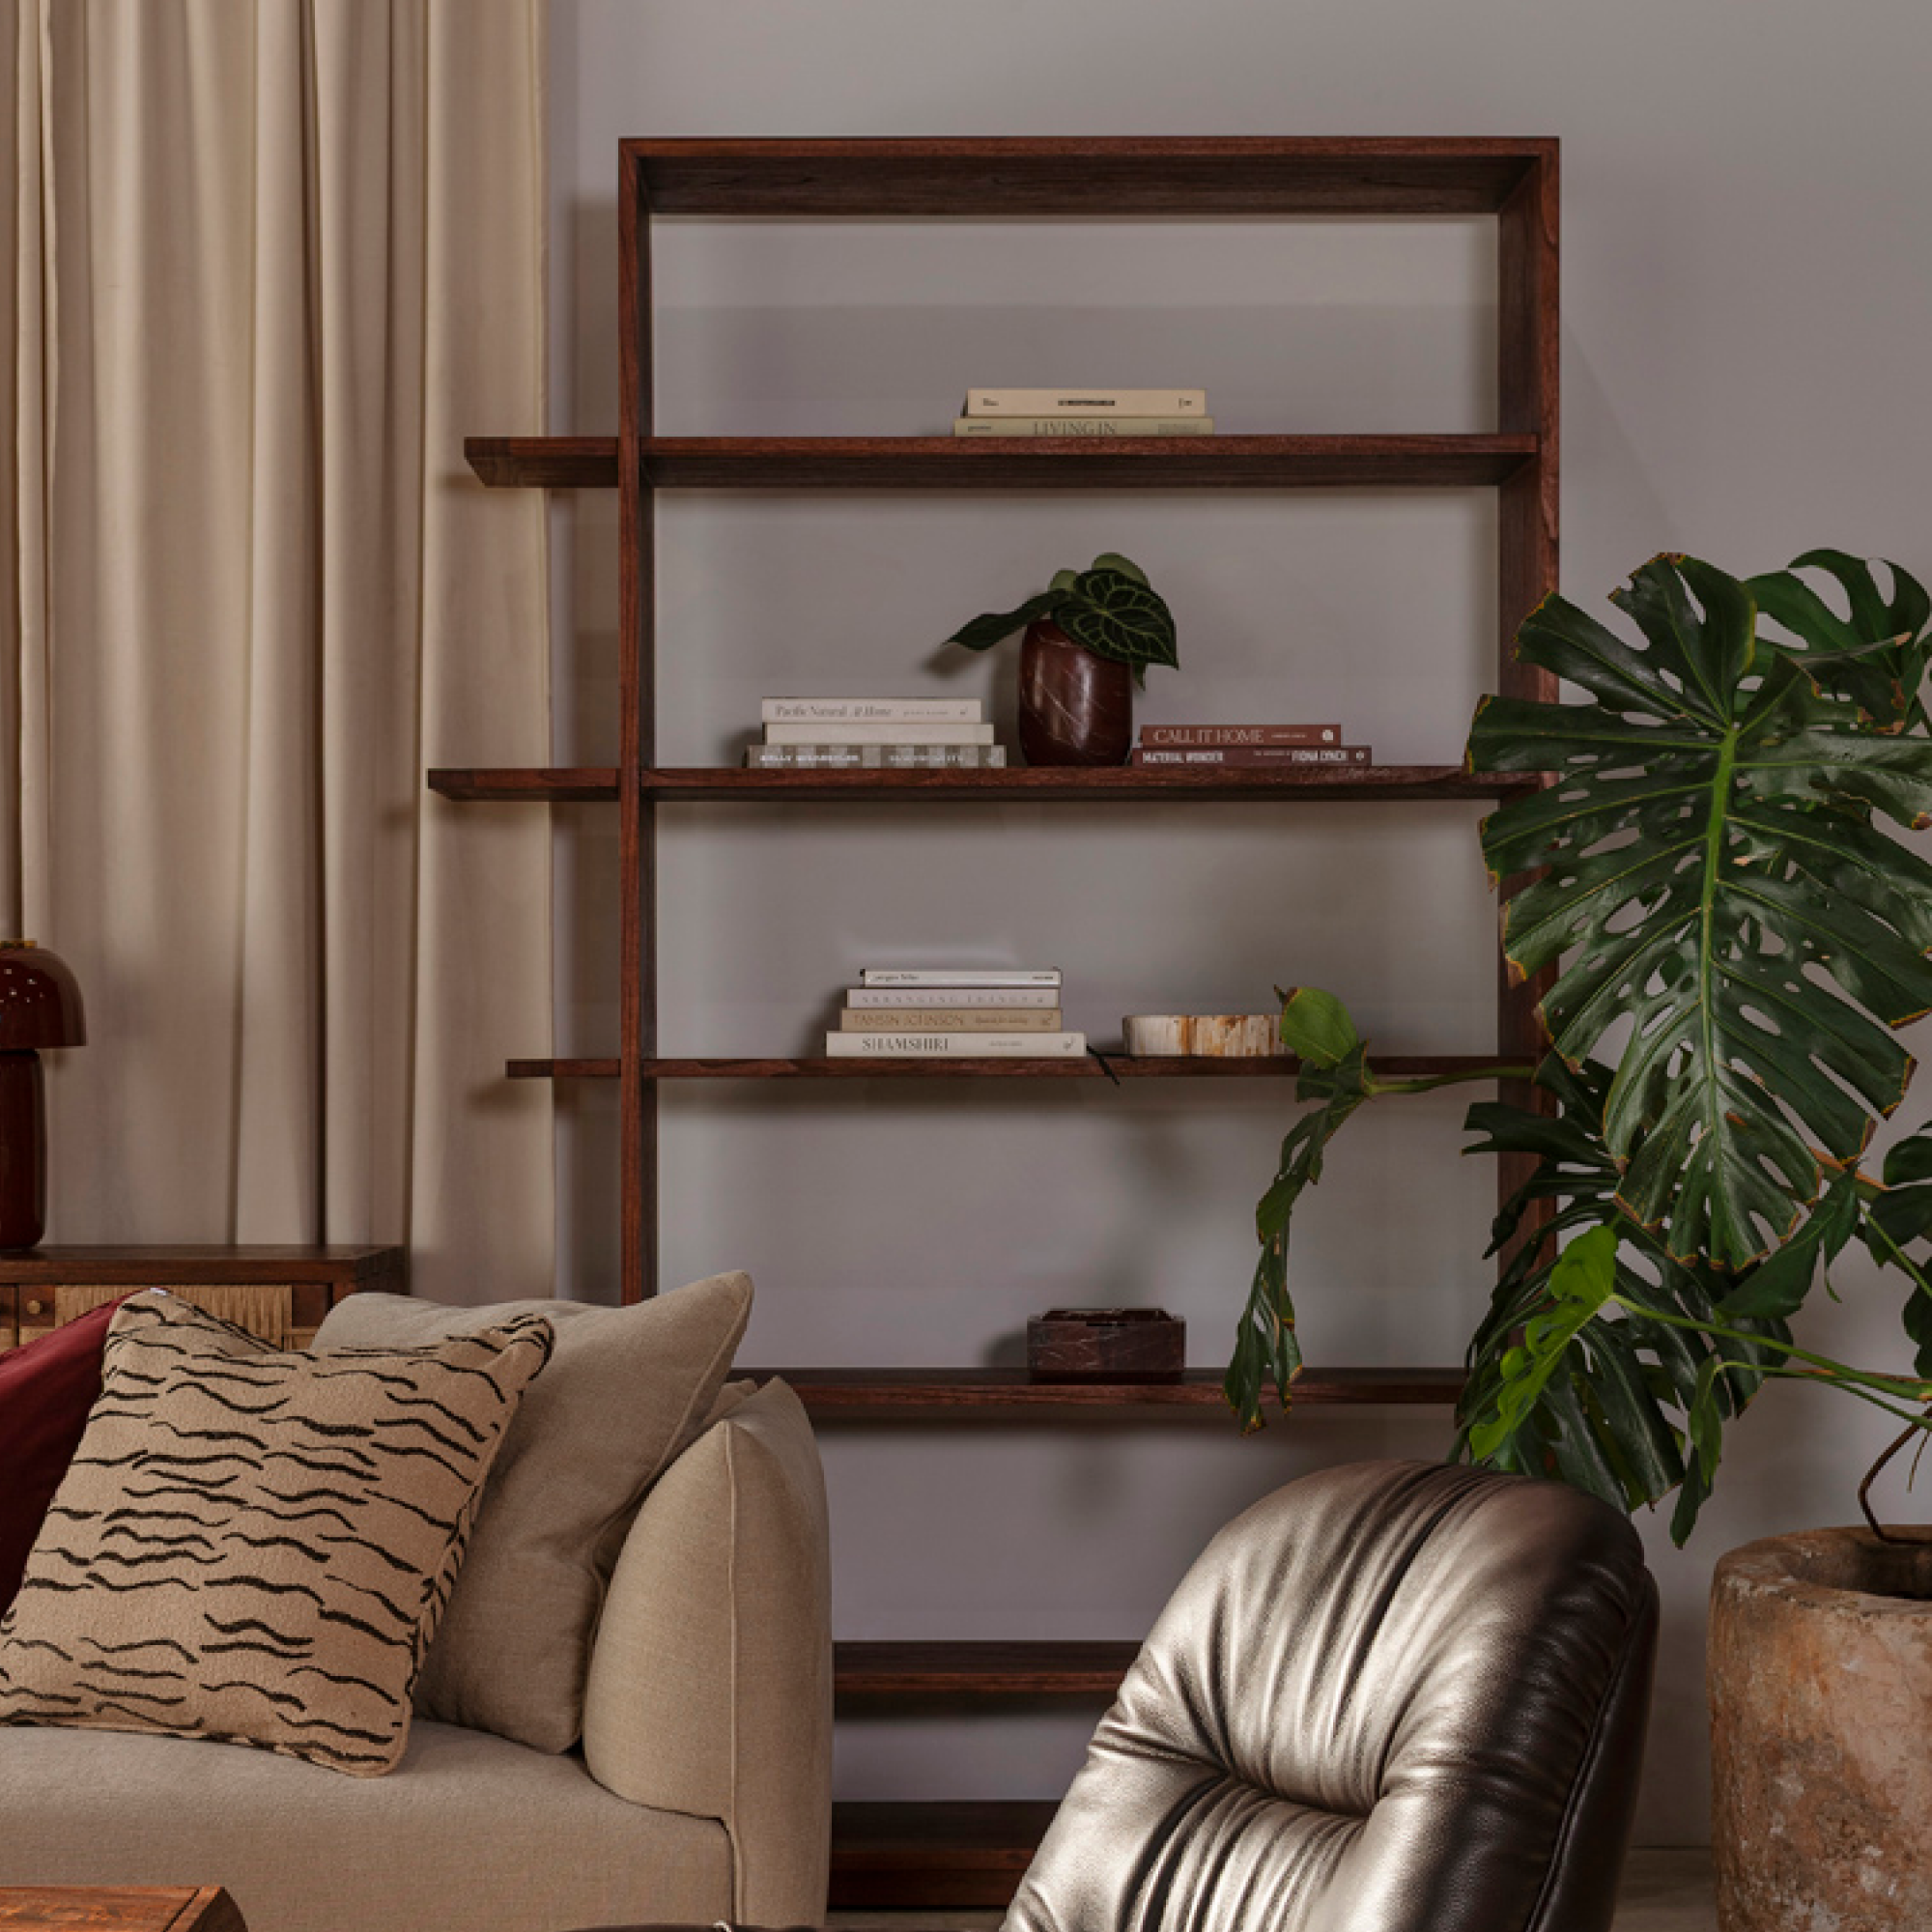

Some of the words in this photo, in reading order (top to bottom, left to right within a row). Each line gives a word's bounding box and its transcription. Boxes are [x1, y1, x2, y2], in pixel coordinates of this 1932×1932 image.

[1034, 420, 1094, 435] LIVING
[1098, 420, 1117, 435] IN
[775, 705, 807, 717] Pacific
[810, 705, 847, 717] Natural
[1152, 729, 1195, 743] CALL
[1197, 729, 1213, 743] IT
[1216, 729, 1264, 743] HOME
[903, 1014, 964, 1026] JOHNSON
[862, 1037, 949, 1051] SHAMSHIRI
